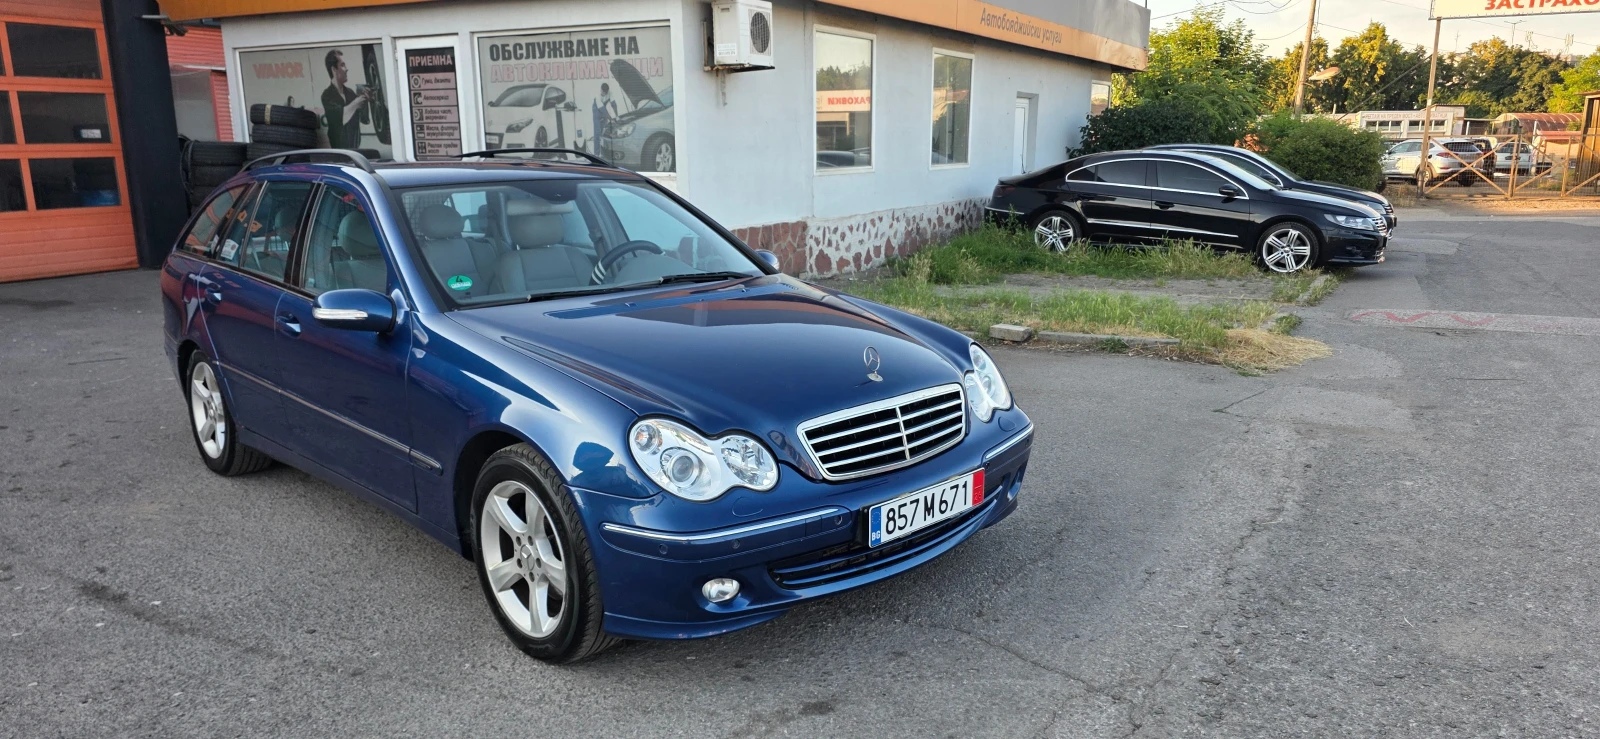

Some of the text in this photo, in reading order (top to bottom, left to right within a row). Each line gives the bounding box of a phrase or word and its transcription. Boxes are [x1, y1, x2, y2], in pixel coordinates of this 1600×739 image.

[980, 7, 1063, 46] Автобояджийски услуги
[409, 55, 453, 67] ПРИЕМНА
[489, 36, 640, 61] ОБСЛУЖВАНЕ НА
[490, 57, 664, 82] АВТОКЛИМАЦИ
[871, 530, 881, 541] BG
